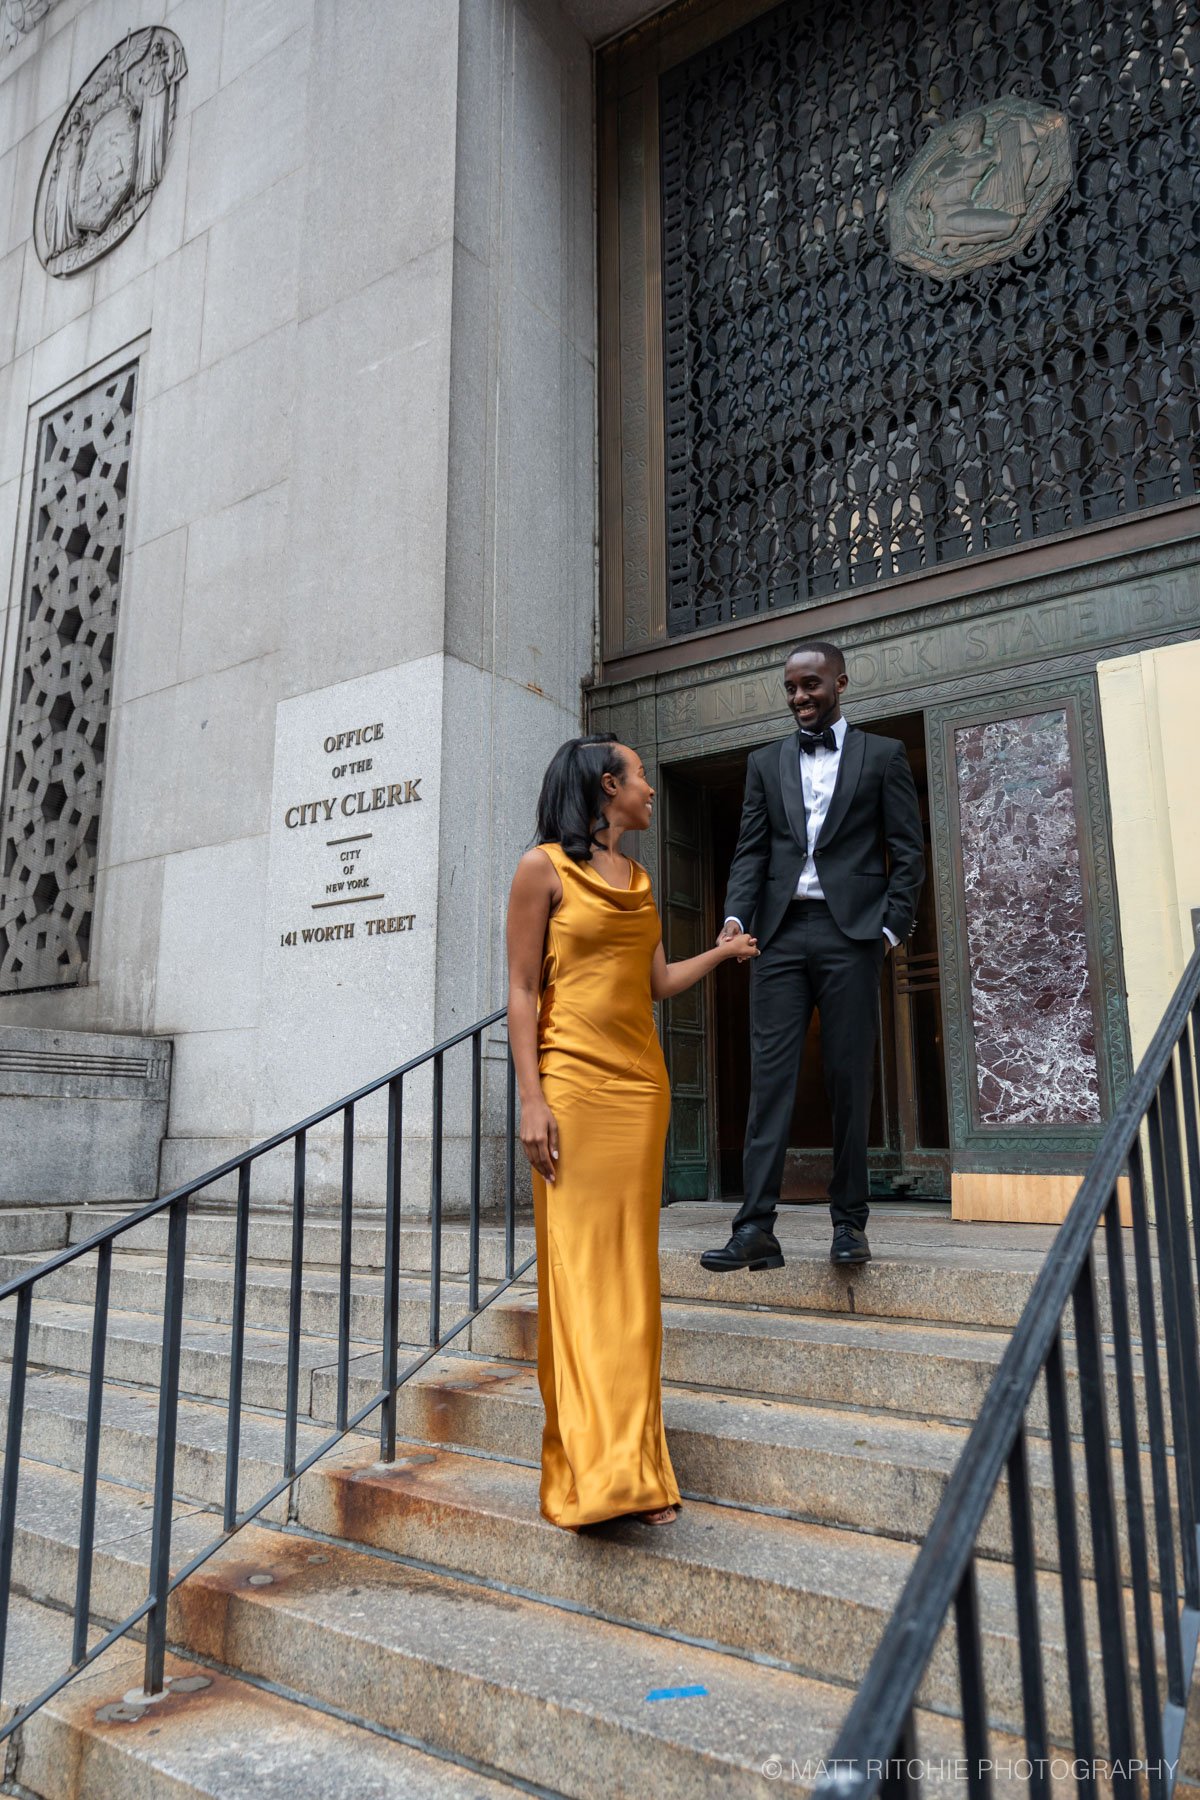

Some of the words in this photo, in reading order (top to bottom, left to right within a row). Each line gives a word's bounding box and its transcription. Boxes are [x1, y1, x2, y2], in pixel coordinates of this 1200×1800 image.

[66, 217, 128, 269] EXCELSIOR
[713, 677, 787, 719] NEW
[846, 636, 937, 687] ORK
[965, 598, 1098, 662] STATE
[323, 722, 384, 754] OFFICE
[331, 764, 348, 779] OF
[349, 758, 373, 775] THE
[284, 797, 337, 829] CITY
[340, 778, 422, 817] CLERK
[340, 849, 361, 861] CITY
[343, 864, 355, 875] OF
[325, 882, 345, 894] NEW
[346, 877, 369, 890] YORK
[280, 931, 297, 947] 141
[301, 922, 355, 944] WORTH
[366, 914, 416, 936] TREET
